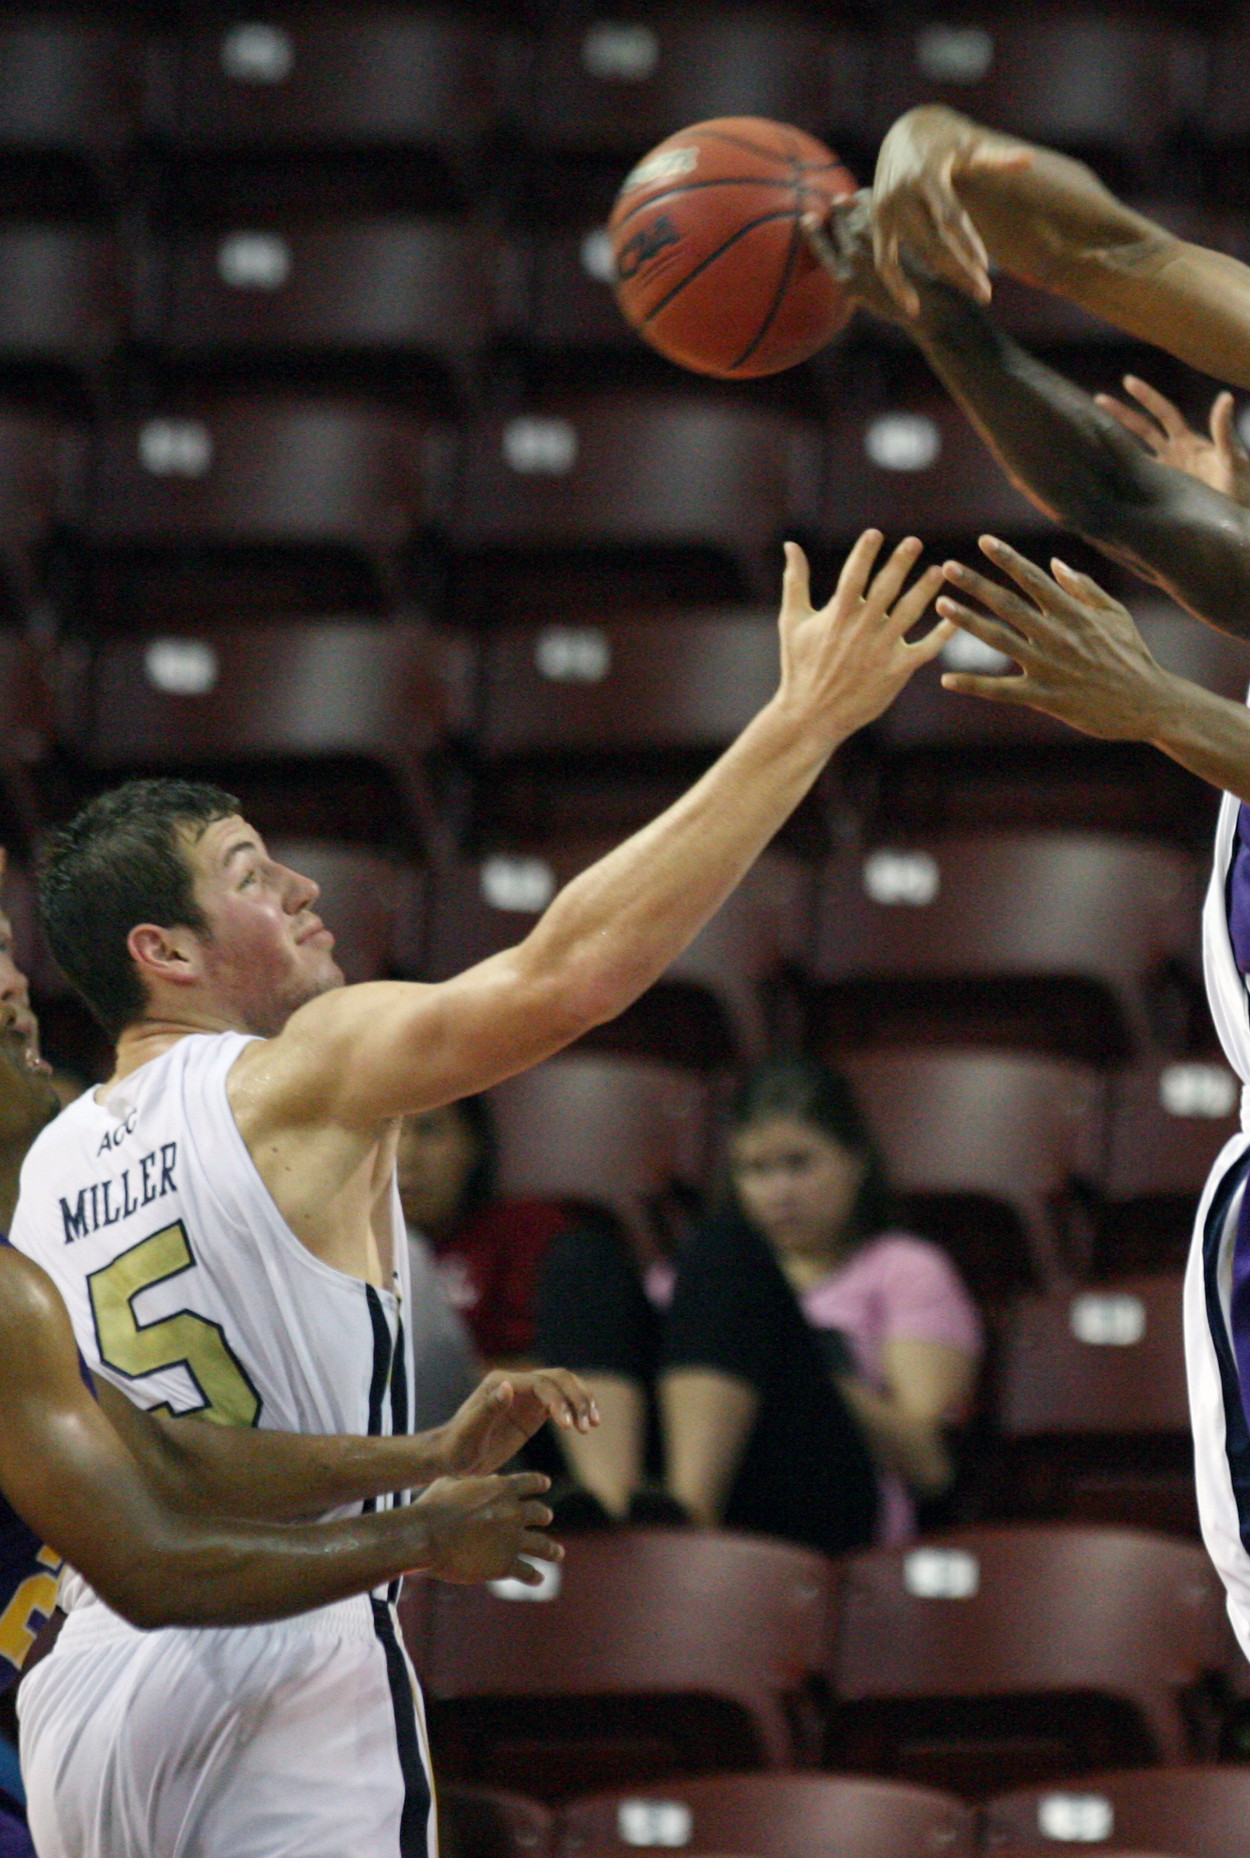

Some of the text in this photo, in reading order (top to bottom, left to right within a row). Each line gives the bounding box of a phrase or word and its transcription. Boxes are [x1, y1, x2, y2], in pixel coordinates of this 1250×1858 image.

[97, 1107, 138, 1157] ACC
[58, 1140, 178, 1245] MILLER
[85, 1218, 264, 1428] 5
